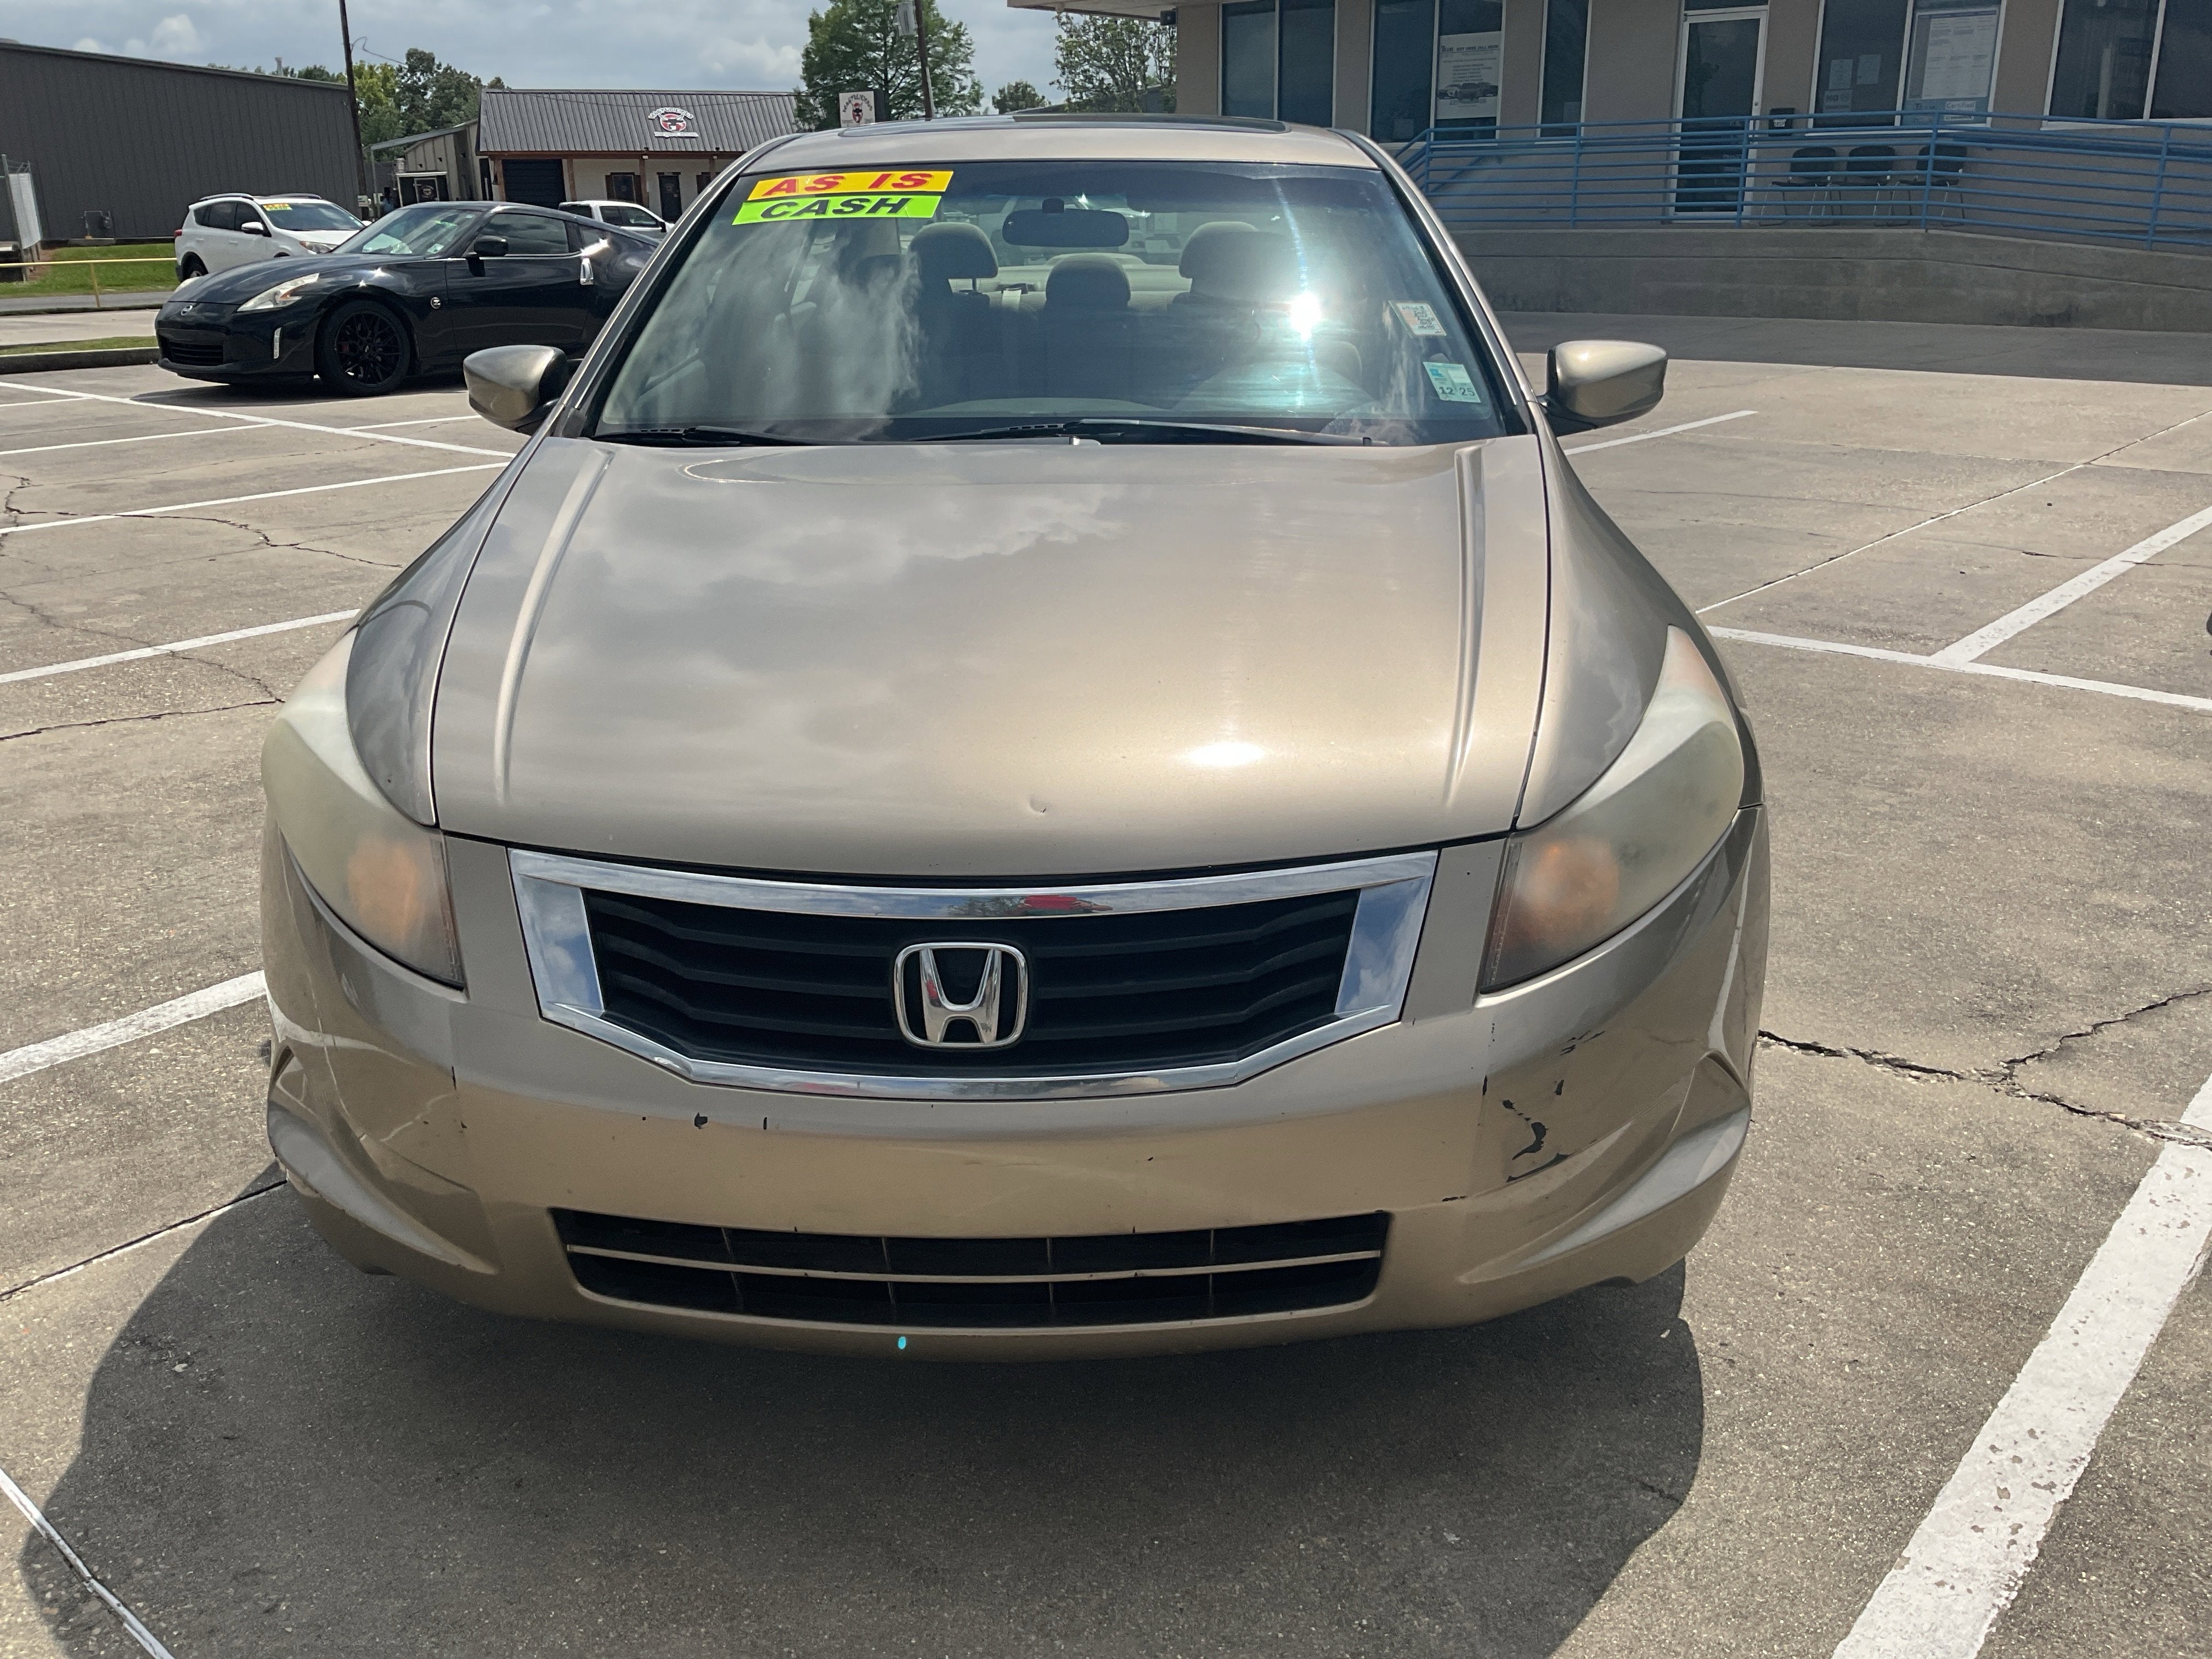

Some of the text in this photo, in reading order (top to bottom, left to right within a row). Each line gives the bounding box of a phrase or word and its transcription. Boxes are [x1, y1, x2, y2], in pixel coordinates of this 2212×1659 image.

[763, 173, 933, 197] AS IS
[760, 197, 913, 218] CASH
[1439, 386, 1475, 396] 12 25
